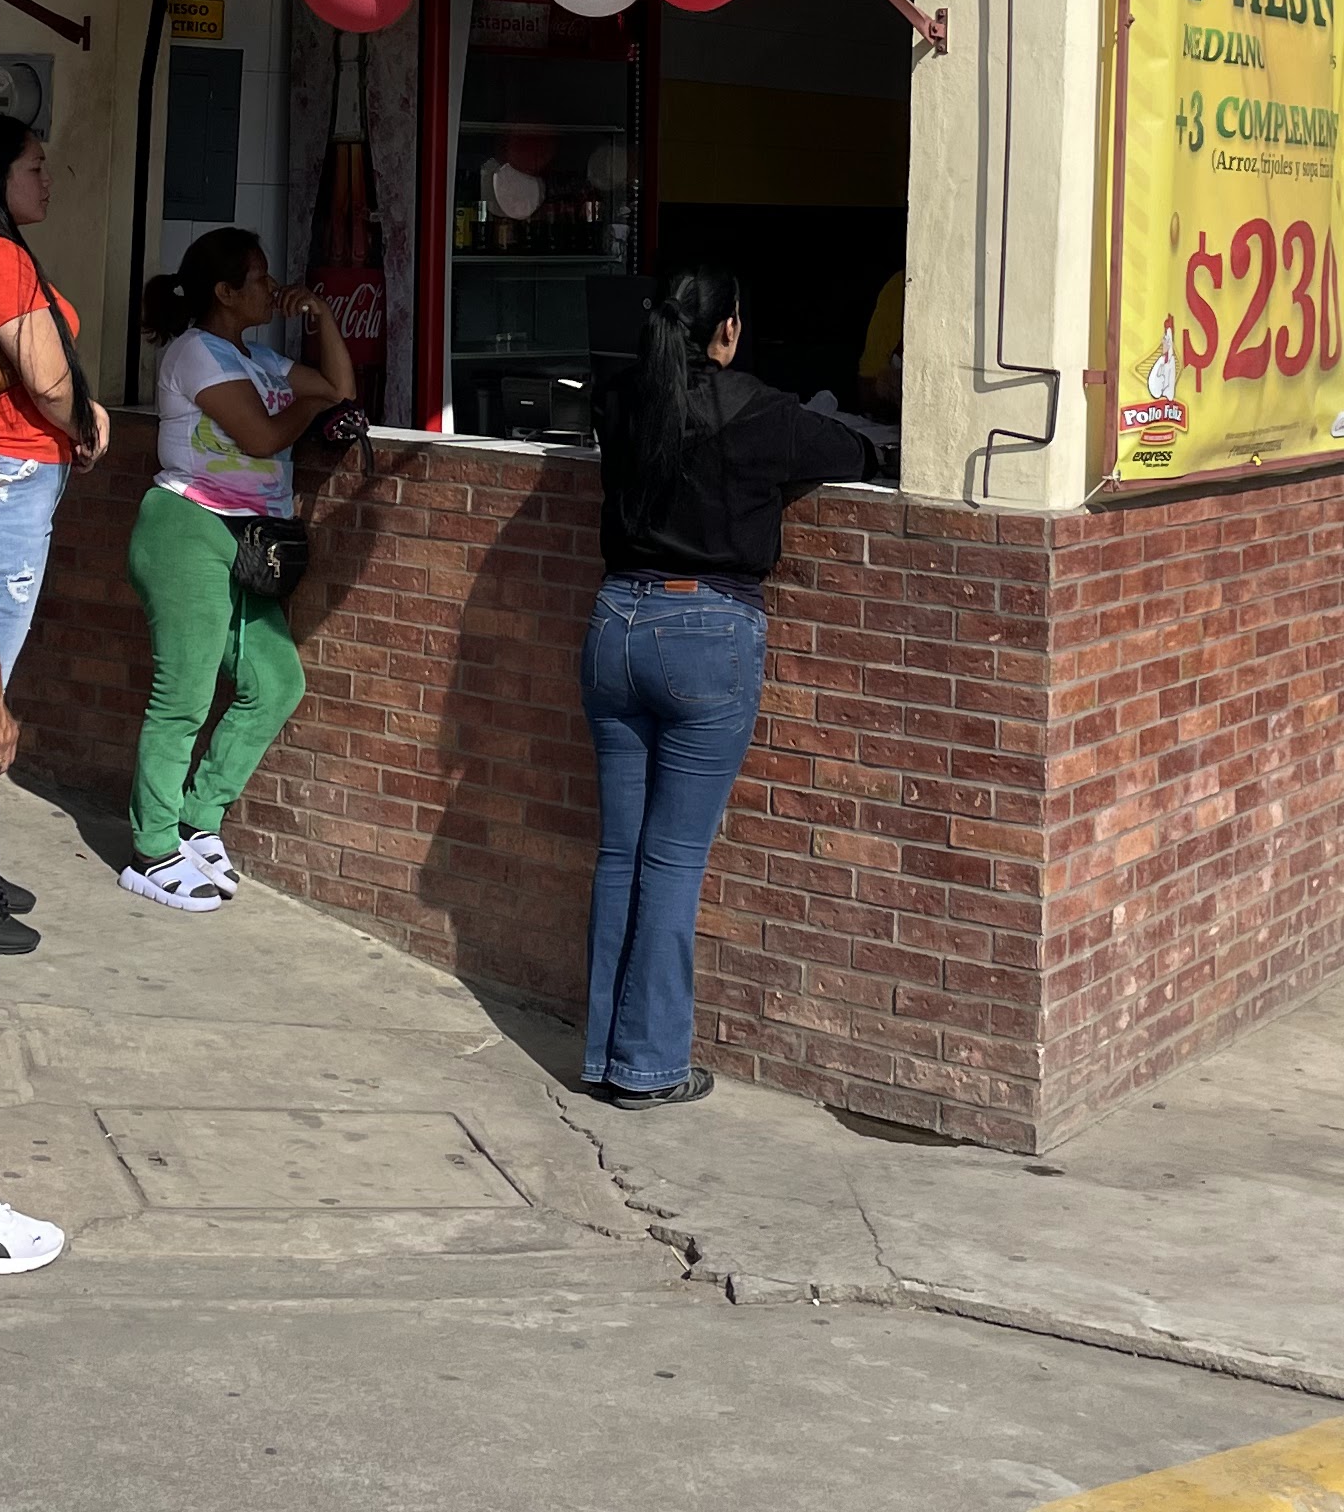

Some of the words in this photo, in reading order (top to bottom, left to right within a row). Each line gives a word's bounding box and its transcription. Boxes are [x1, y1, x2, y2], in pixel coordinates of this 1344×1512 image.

[1175, 89, 1205, 153] +3
[1183, 218, 1343, 393] $230
[1123, 407, 1162, 426] Pollo
